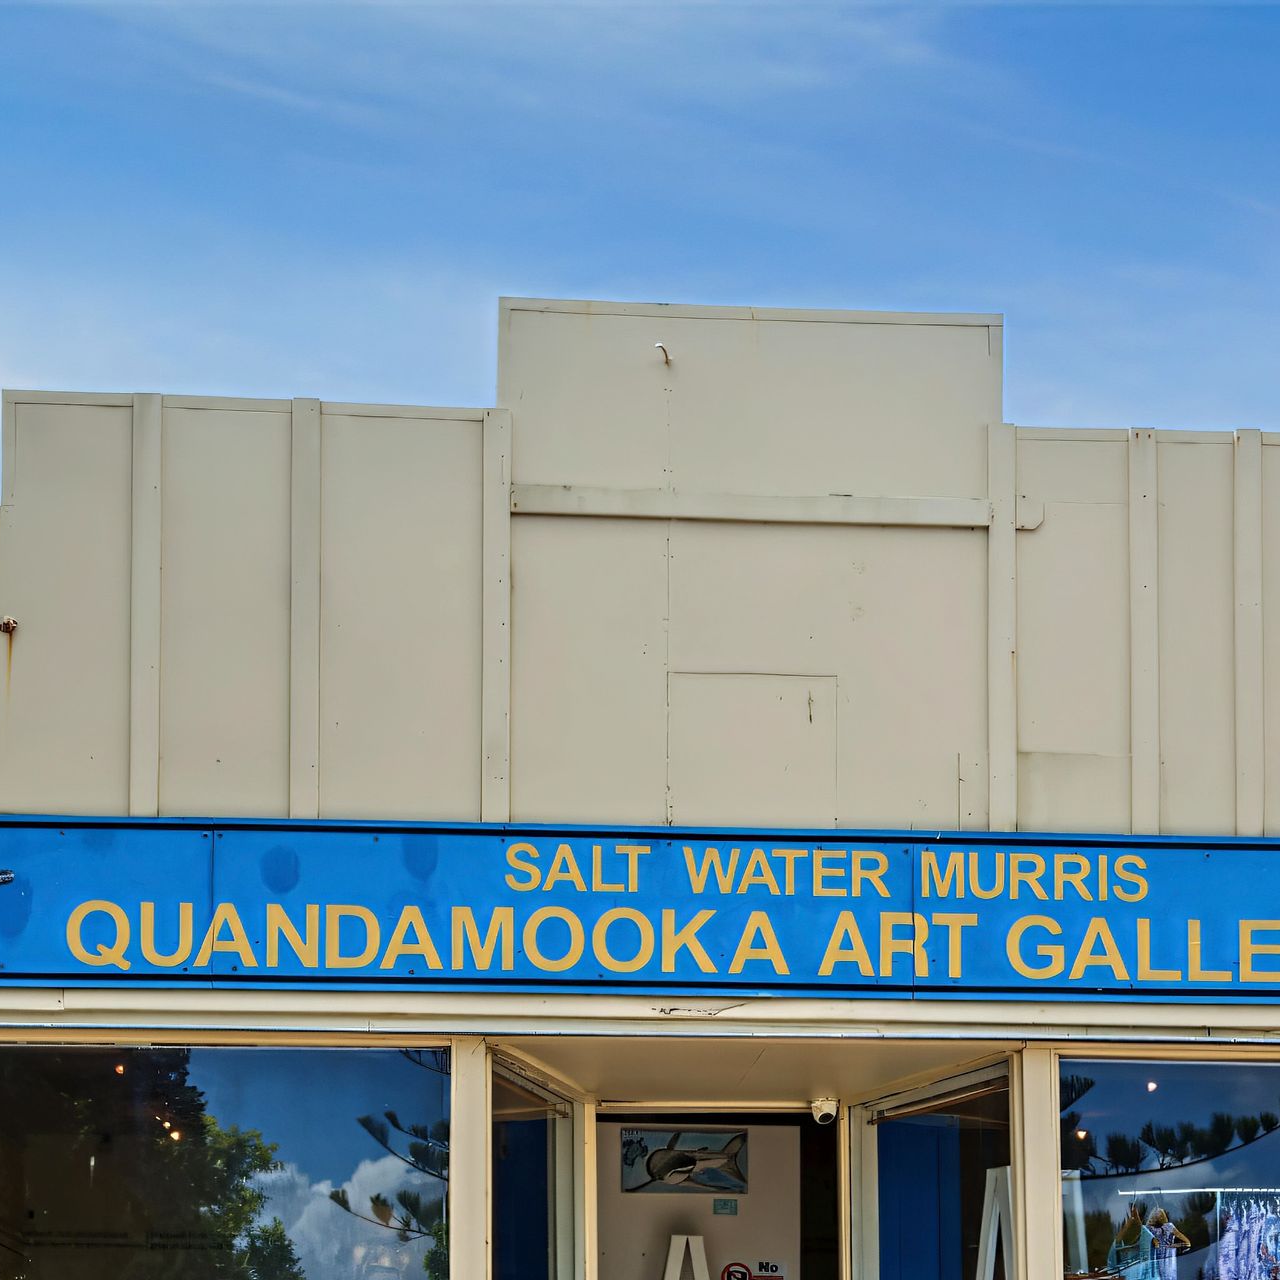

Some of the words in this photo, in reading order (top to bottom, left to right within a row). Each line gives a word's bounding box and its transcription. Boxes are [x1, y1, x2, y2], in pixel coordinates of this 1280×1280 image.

[505, 843, 651, 893] SALT
[682, 847, 890, 898] WATER
[921, 851, 1150, 903] MURRIS
[66, 899, 790, 977] QUANDAMOOKA
[818, 910, 978, 978] ART
